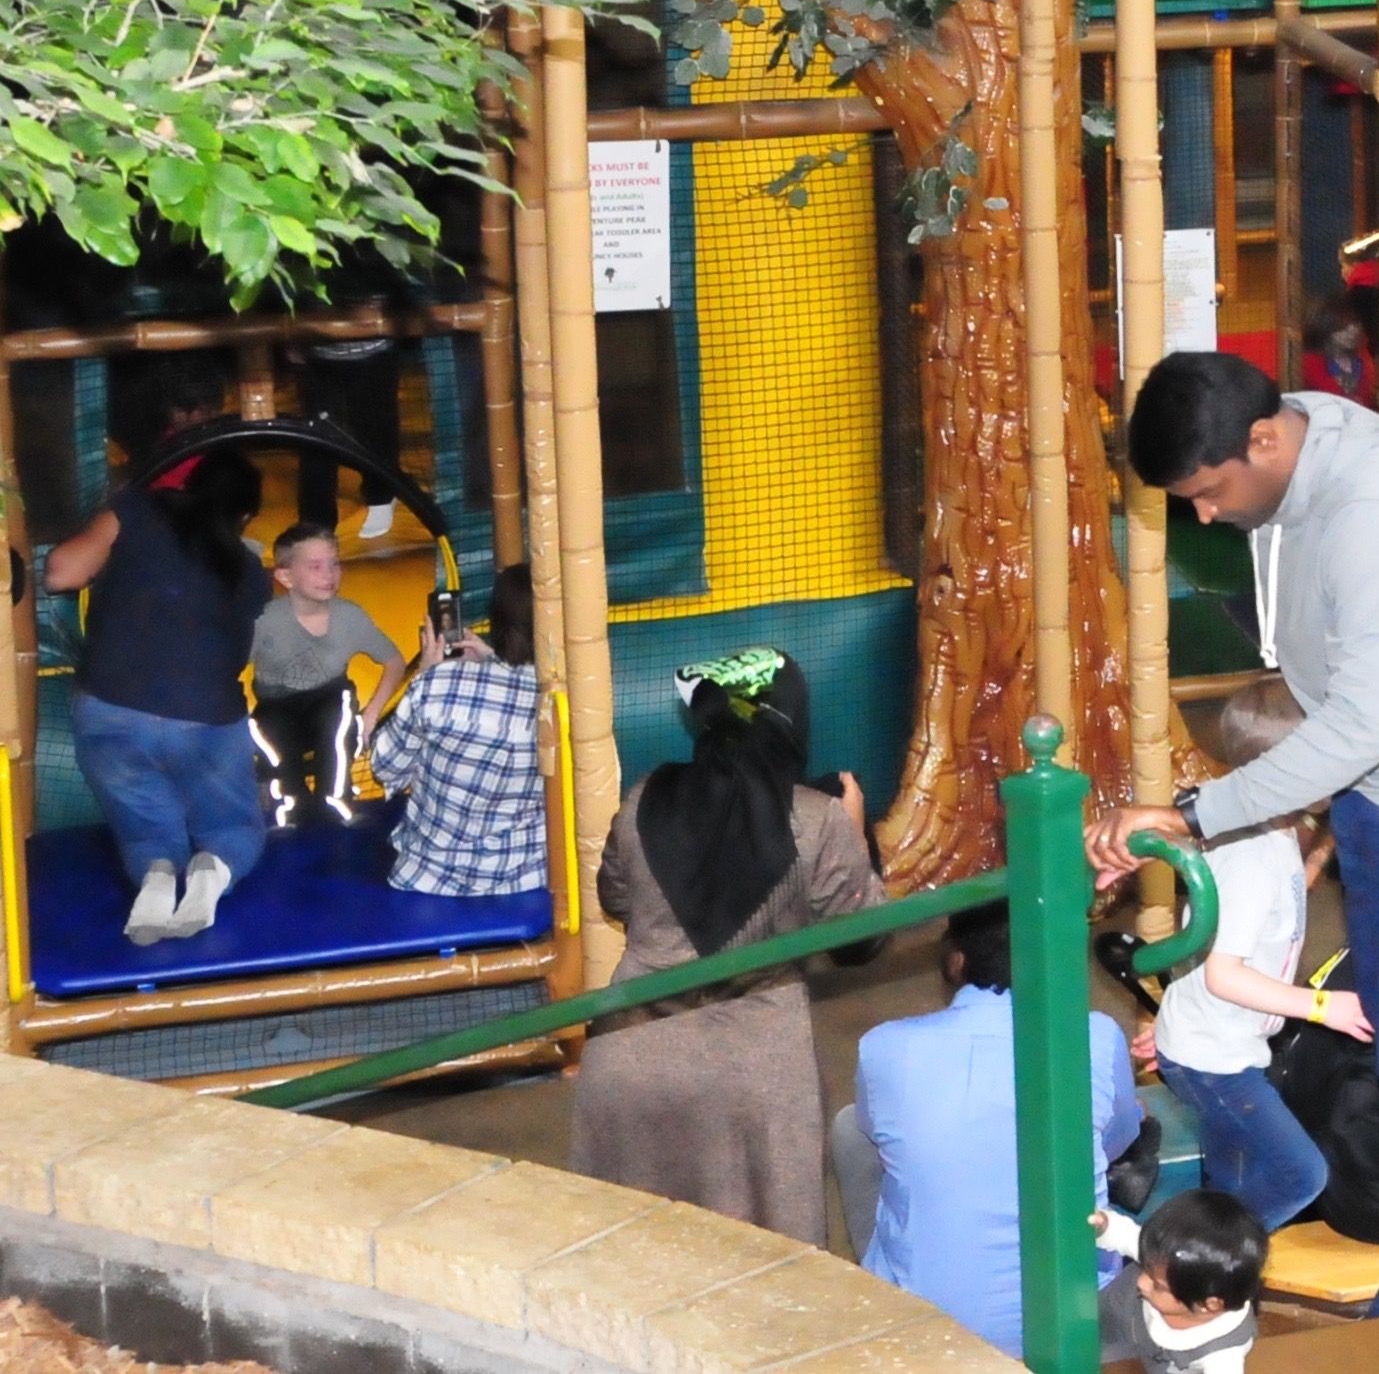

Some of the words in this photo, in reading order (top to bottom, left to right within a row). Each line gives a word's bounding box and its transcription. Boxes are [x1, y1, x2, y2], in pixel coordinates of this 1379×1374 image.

[591, 164, 604, 172] KS
[606, 162, 634, 172] MUST
[637, 161, 650, 171] BE
[595, 178, 607, 187] BY
[610, 176, 661, 187] EVERYONE
